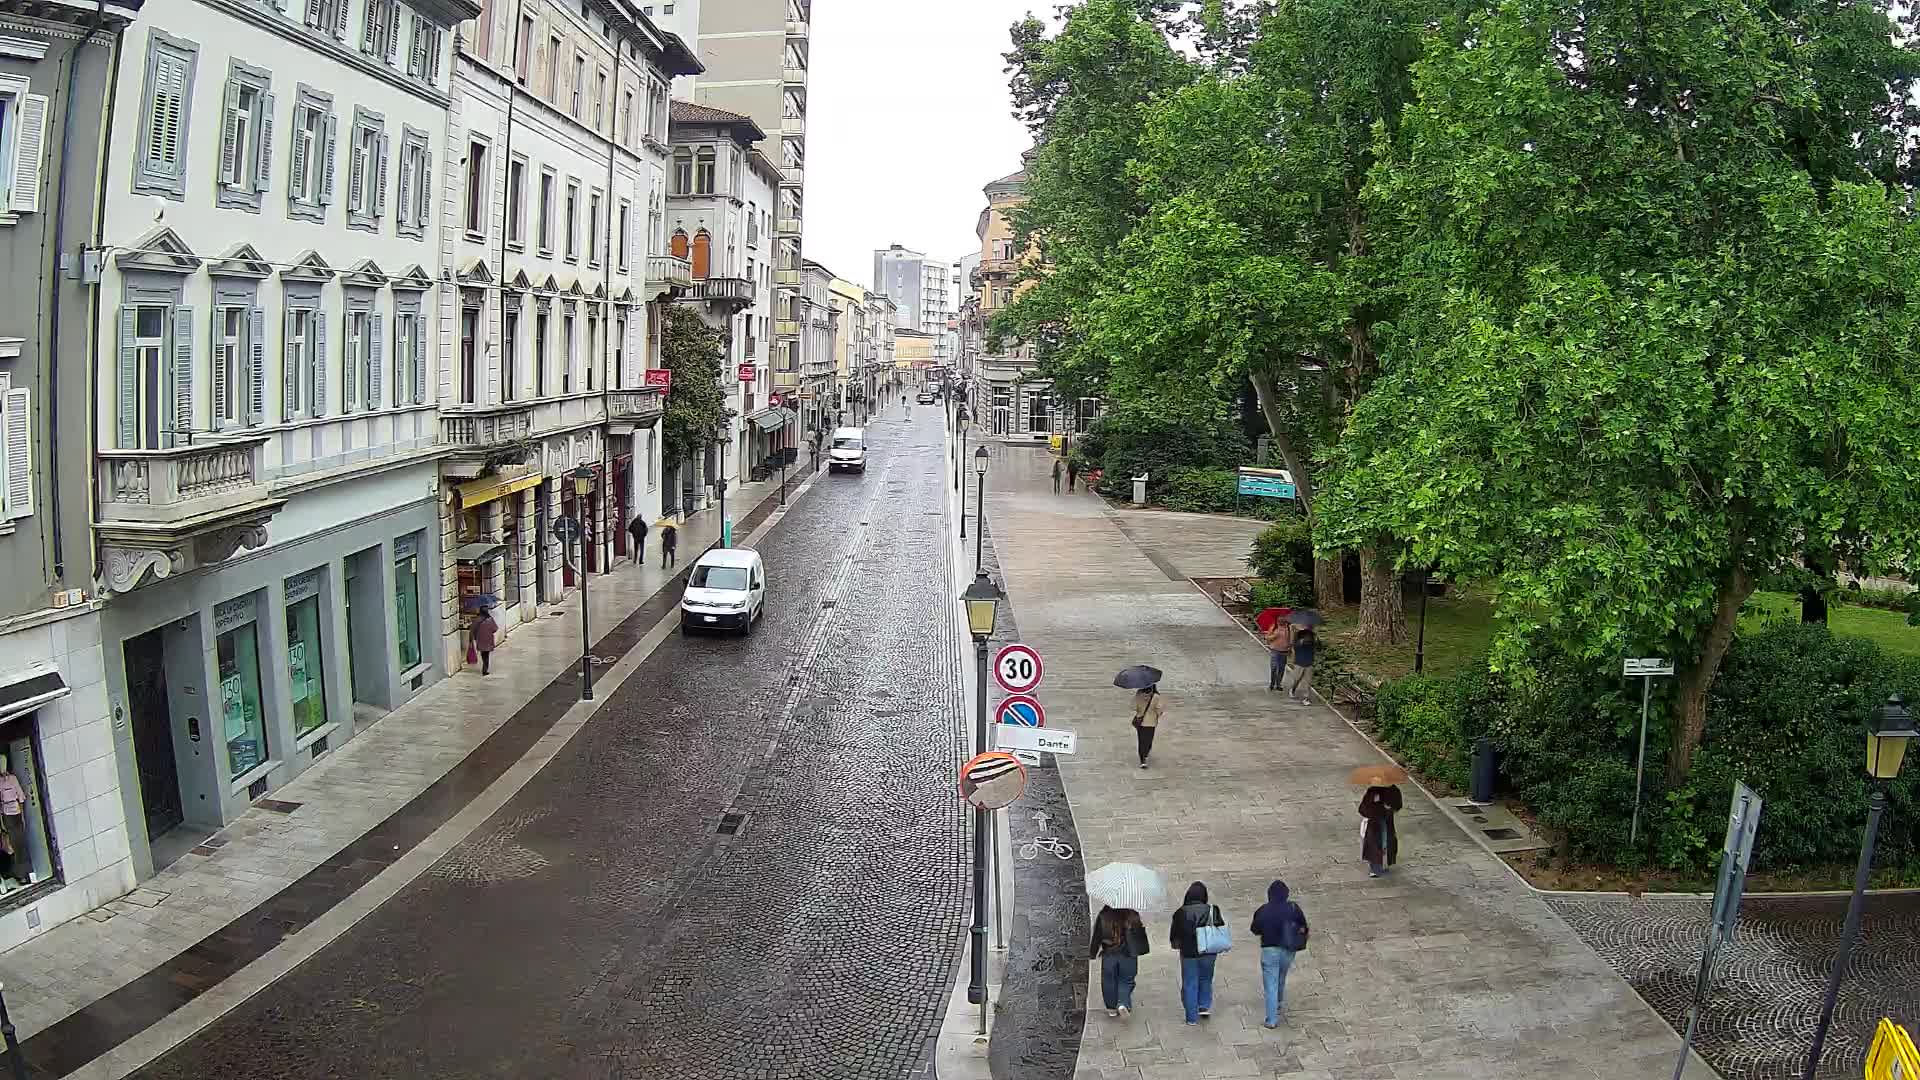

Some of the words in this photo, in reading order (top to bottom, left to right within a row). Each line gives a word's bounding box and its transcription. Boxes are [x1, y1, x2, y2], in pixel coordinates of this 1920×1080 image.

[1005, 658, 1032, 679] 30
[223, 677, 240, 700] 130
[1038, 738, 1069, 749] Dante
